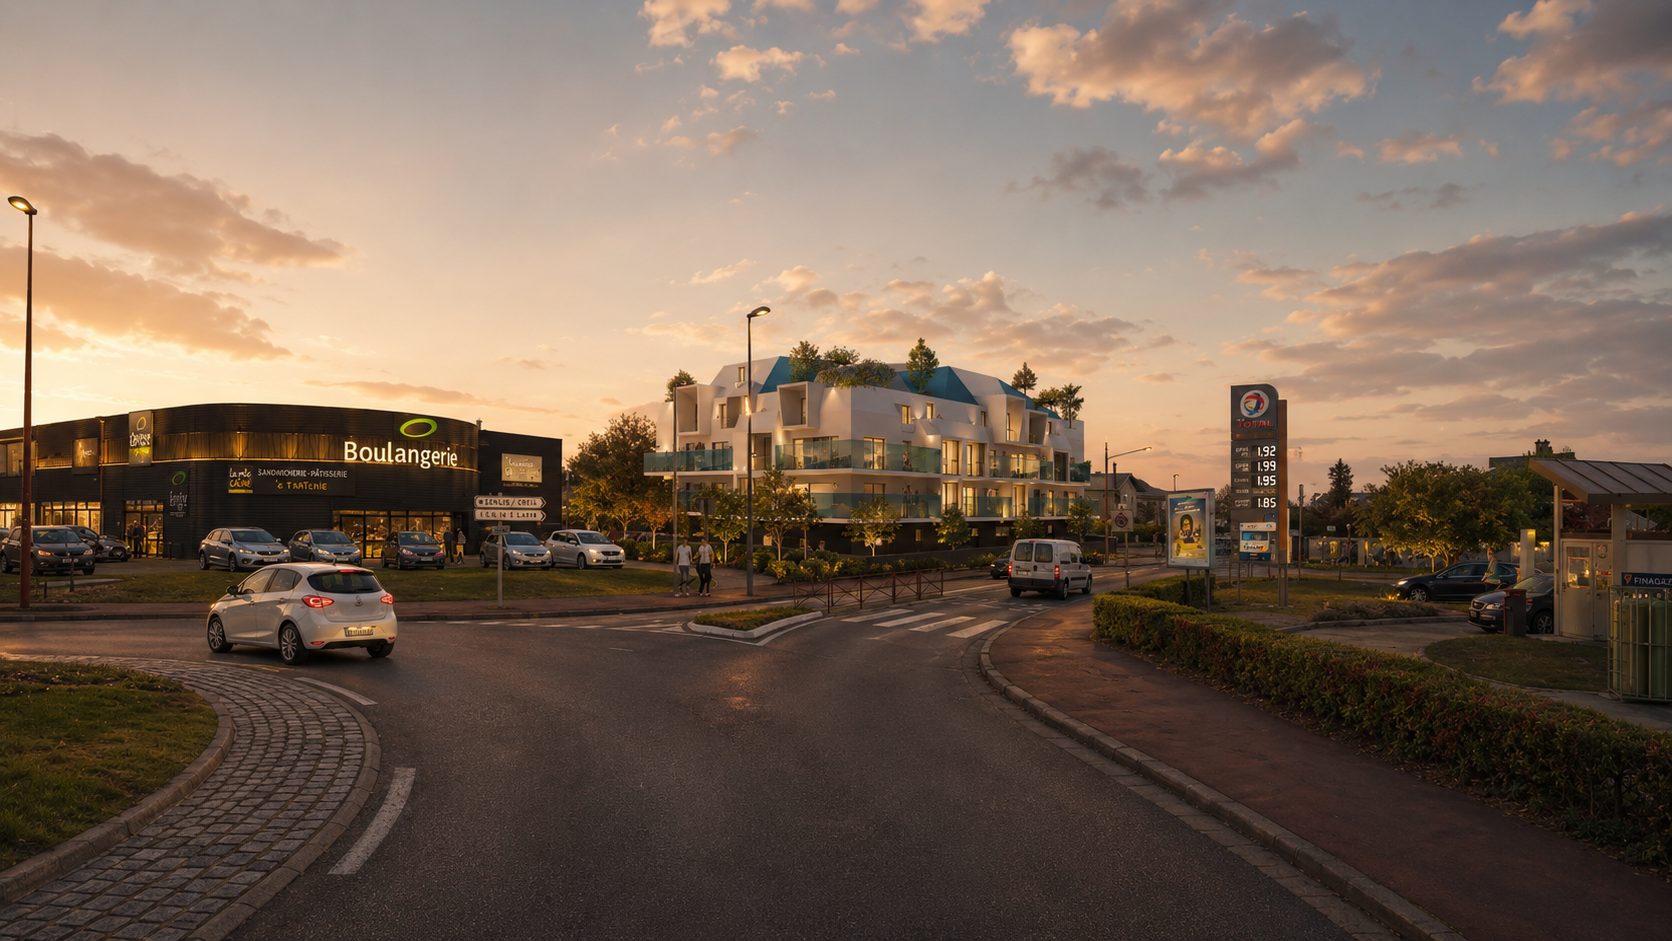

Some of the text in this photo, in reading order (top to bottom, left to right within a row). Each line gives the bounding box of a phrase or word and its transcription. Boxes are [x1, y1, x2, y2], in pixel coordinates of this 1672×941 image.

[344, 441, 458, 469] Boulangerie
[1257, 445, 1276, 457] 1.92
[1257, 460, 1276, 471] 1.99
[1257, 475, 1276, 486] 1.95
[1257, 497, 1276, 508] 1.85
